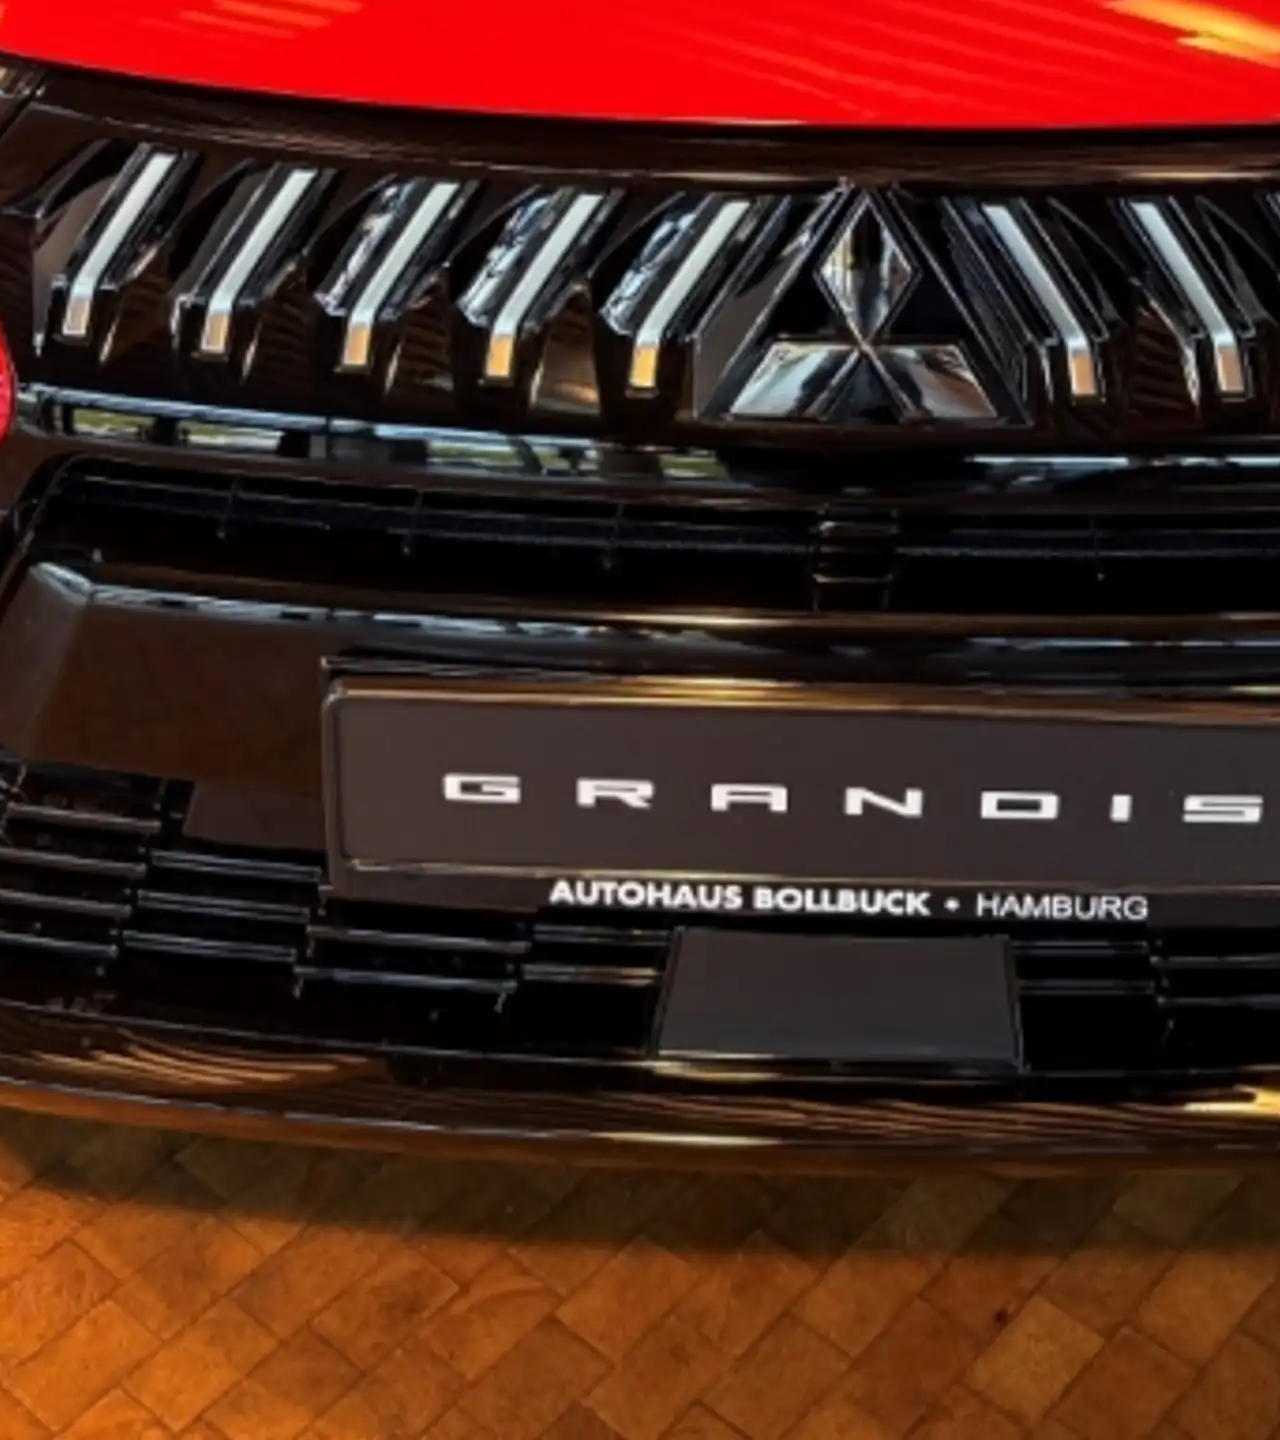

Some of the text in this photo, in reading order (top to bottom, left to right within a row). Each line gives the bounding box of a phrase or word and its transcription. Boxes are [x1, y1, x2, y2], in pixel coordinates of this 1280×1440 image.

[441, 771, 1265, 825] GRANDIS
[548, 879, 1150, 921] AUTOHAUS BOLLBUCK HAMBURG
